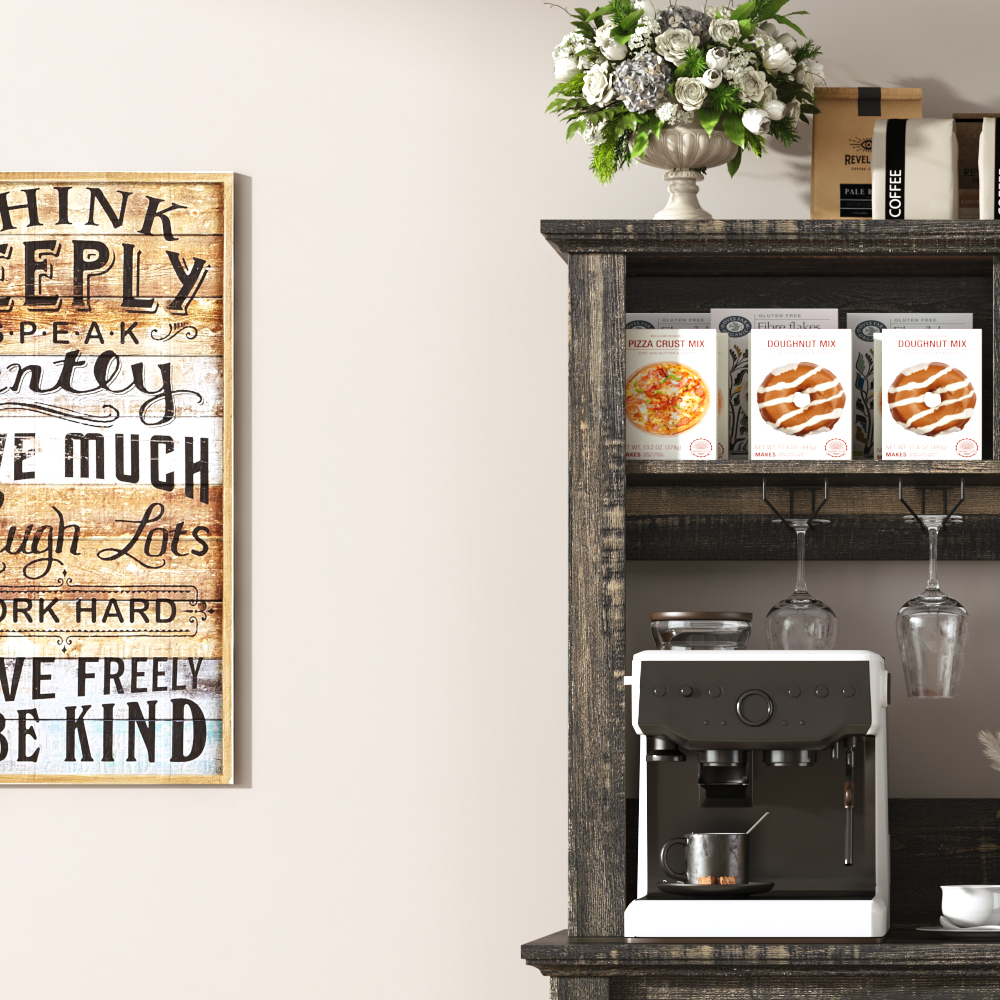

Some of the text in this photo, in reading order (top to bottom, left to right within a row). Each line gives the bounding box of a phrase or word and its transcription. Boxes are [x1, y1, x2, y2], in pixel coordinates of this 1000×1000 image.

[889, 169, 902, 218] COFFEE
[628, 340, 705, 348] PIZZA CRUST MIX
[757, 321, 821, 329] Fibre flakes
[767, 340, 836, 348] DOUGHNUT MIX
[898, 340, 967, 348] DOUGHNUT MIX
[0, 350, 205, 428] ntly
[0, 432, 209, 505] E MUCH
[0, 502, 210, 580] ugh Lots
[0, 597, 177, 624] RK HARD
[77, 656, 204, 697] FREELY
[64, 698, 208, 763] KIND
